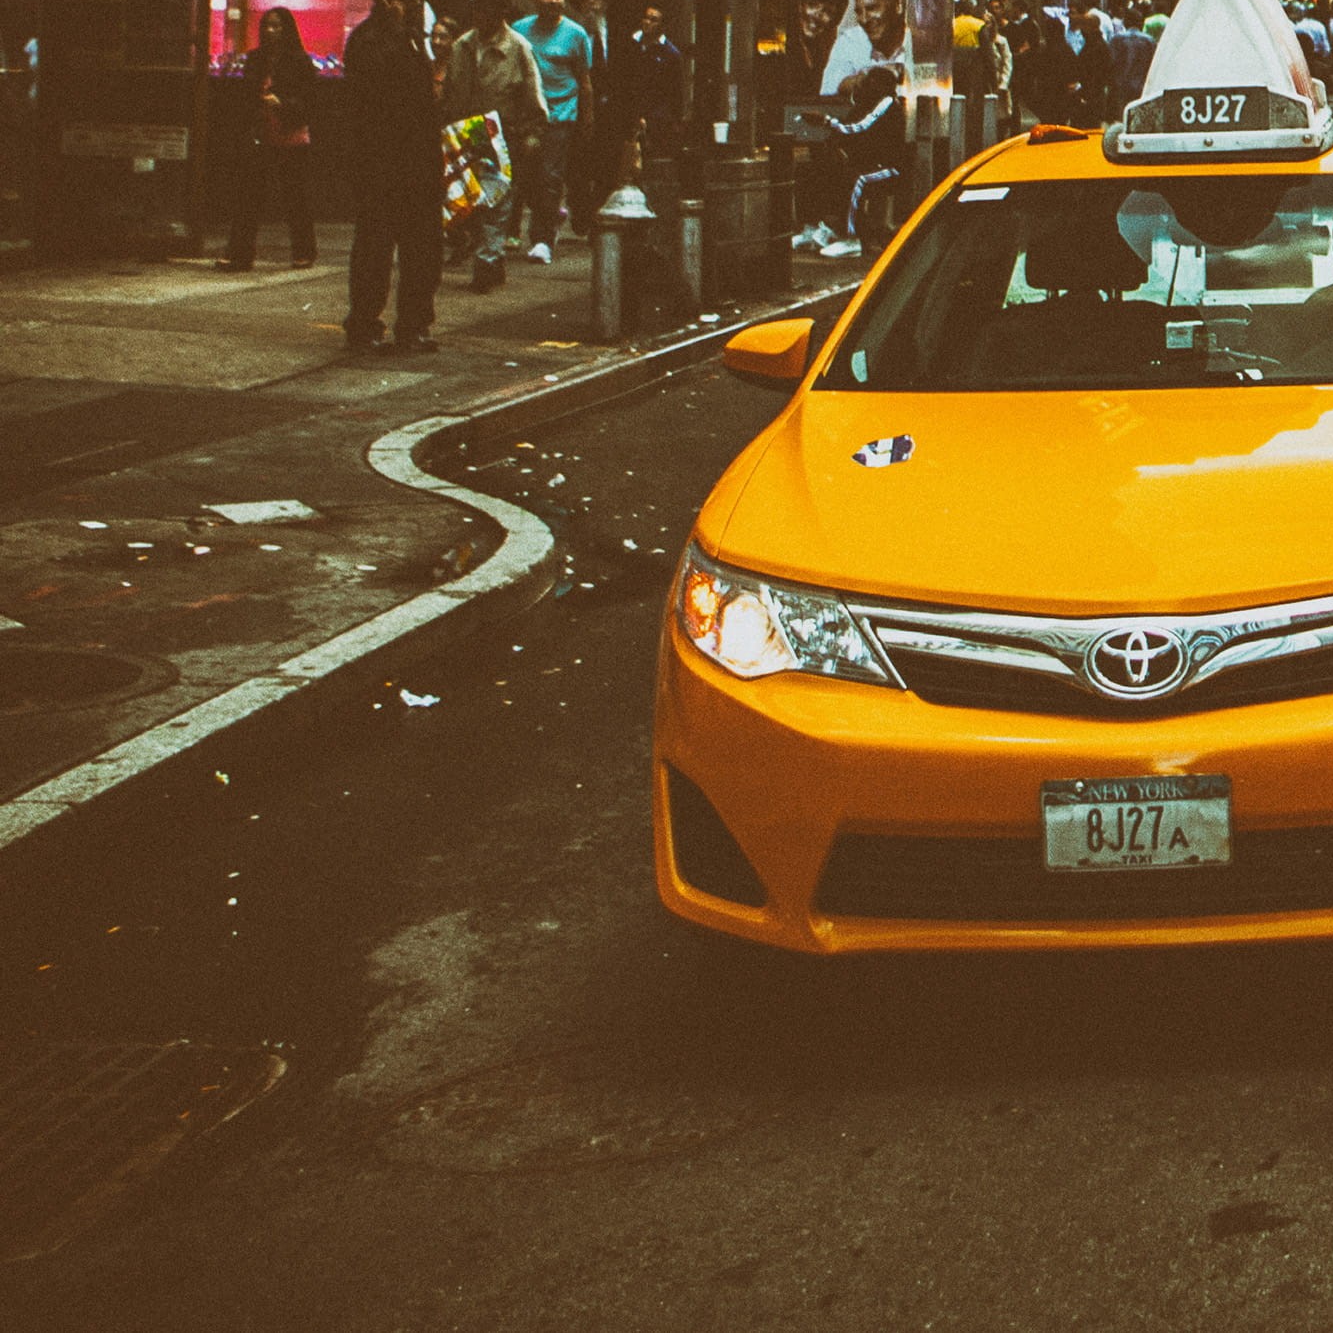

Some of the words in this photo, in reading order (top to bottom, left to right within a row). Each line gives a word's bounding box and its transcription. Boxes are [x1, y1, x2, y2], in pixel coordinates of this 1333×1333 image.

[1179, 94, 1247, 125] 8J27
[1088, 784, 1129, 801] NEW
[1135, 781, 1184, 800] YORK
[1121, 854, 1153, 865] TAXI
